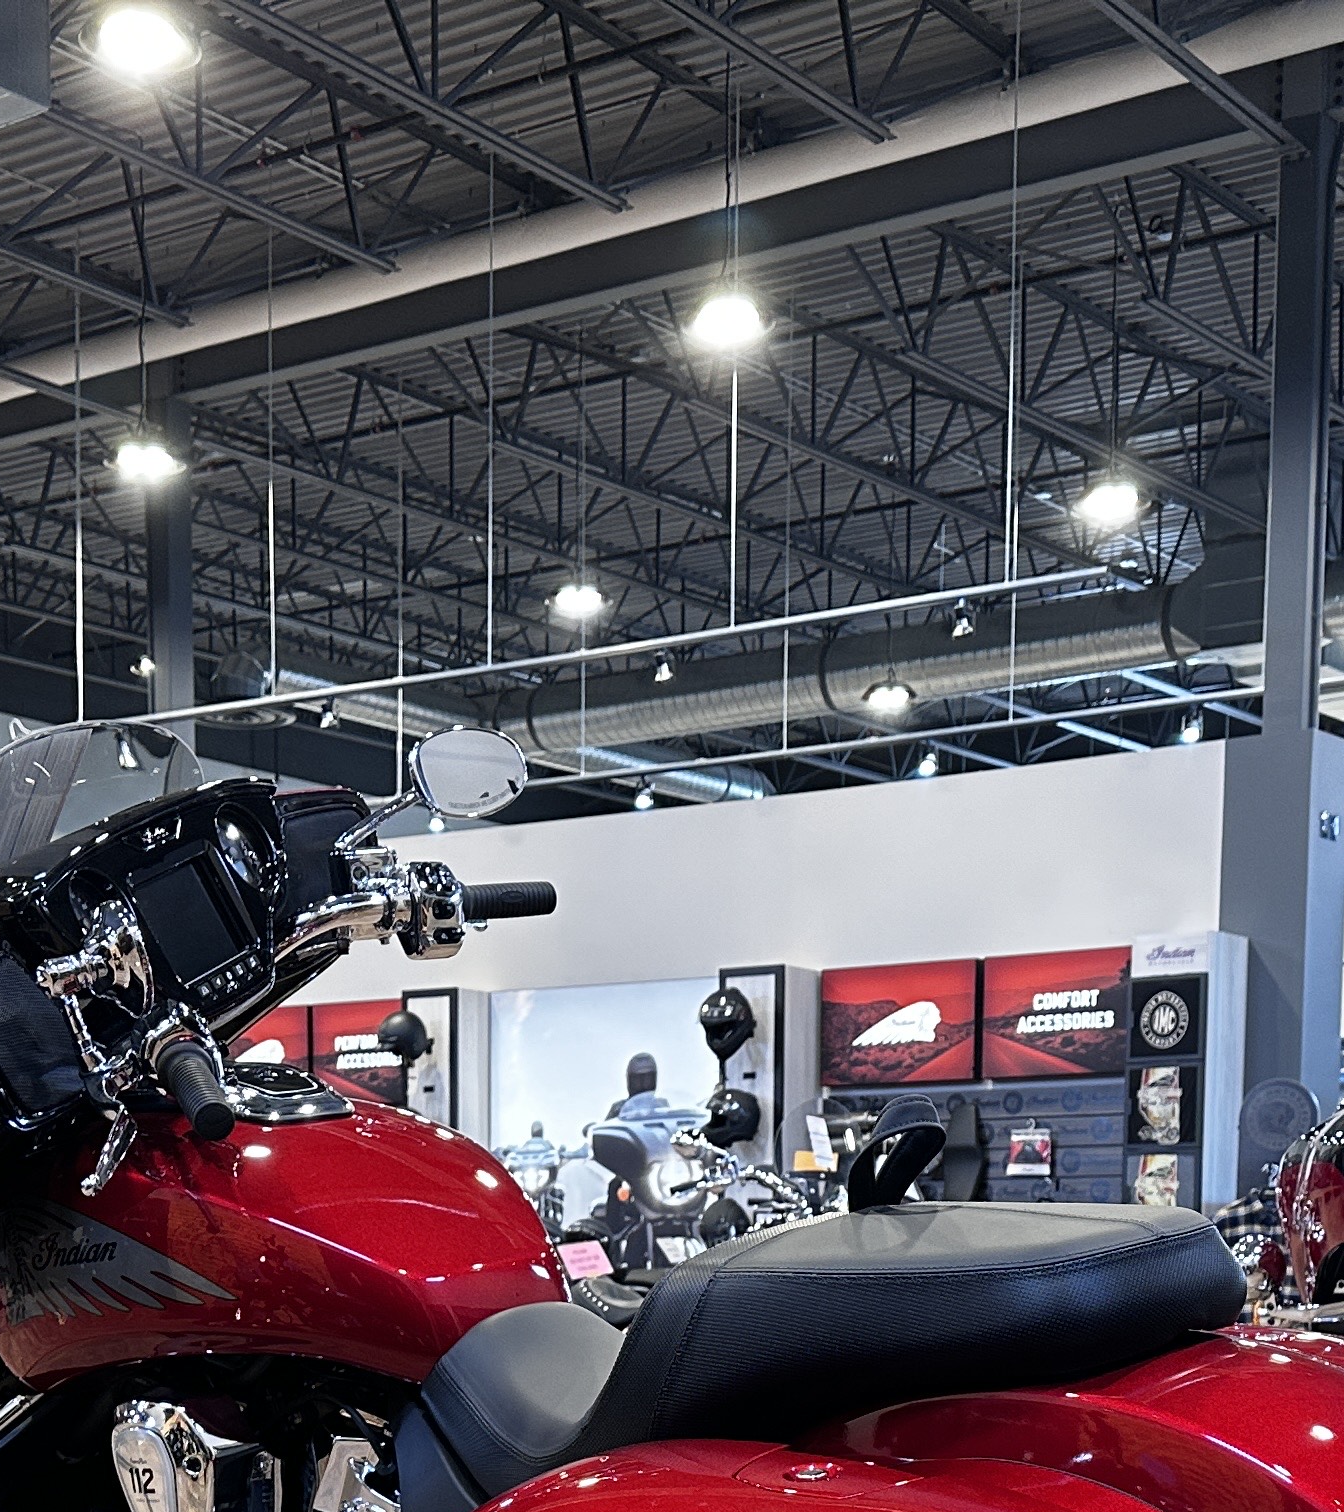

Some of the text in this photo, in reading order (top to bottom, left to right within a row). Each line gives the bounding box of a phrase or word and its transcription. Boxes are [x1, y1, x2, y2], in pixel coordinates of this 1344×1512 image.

[1033, 989, 1099, 1011] COMFORT
[1017, 1010, 1114, 1034] ACCESSORIES
[31, 1231, 118, 1272] Indian
[129, 1467, 156, 1494] 112
